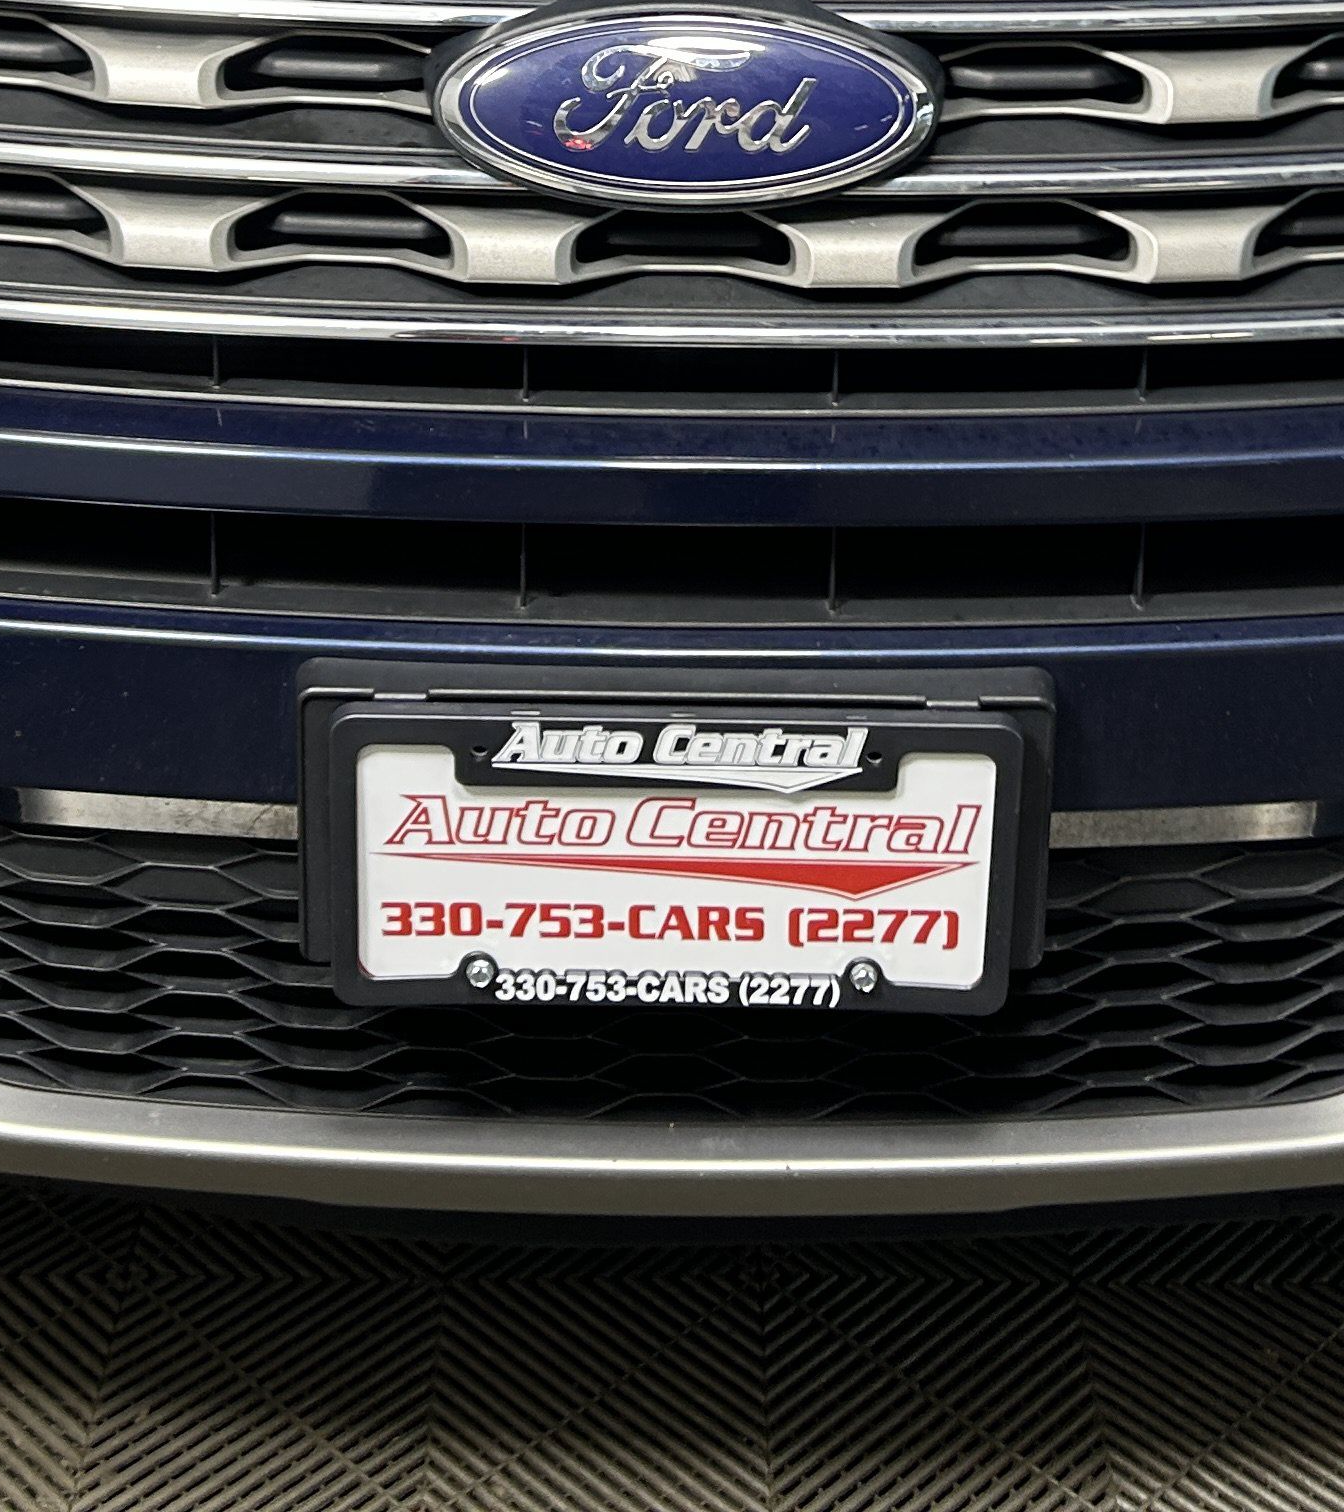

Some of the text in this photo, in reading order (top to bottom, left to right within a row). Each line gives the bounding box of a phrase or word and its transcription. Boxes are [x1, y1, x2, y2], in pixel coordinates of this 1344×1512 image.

[553, 38, 817, 153] Ford
[491, 722, 869, 768] Auto Central
[384, 794, 982, 855] Auto Central
[381, 902, 960, 951] 330-753-CARS (2277)
[494, 972, 841, 1009] 330-753-CARS (2277)
